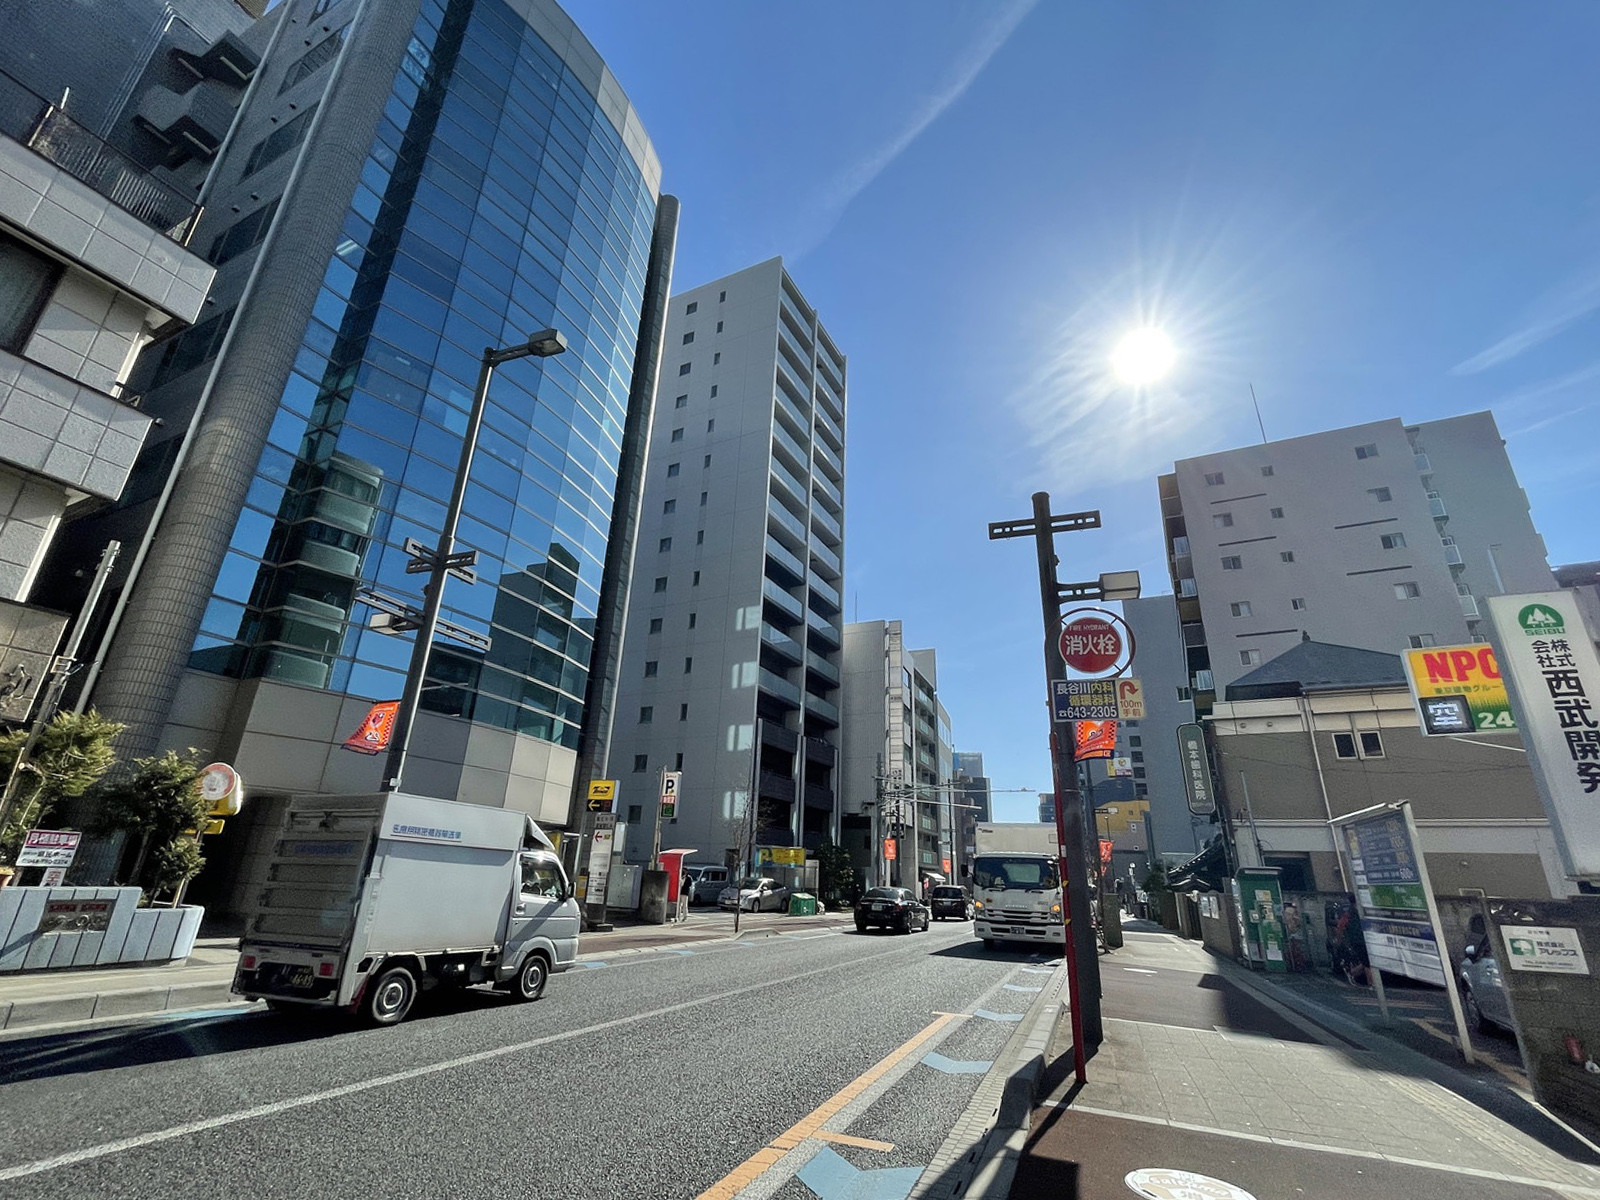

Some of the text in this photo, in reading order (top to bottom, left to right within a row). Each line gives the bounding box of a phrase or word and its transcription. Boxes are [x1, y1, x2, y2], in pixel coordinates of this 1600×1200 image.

[1525, 628, 1566, 636] SEIBU
[1065, 634, 1117, 655] 消火栓
[1057, 681, 1114, 695] 長谷川内科
[1434, 684, 1503, 694] 東京建物グルー
[1069, 694, 1115, 706] 循環器科
[1067, 706, 1117, 718] 643-2305
[1428, 703, 1462, 725] 空
[1187, 740, 1207, 800] 橋本歯科医院
[665, 779, 675, 795] P
